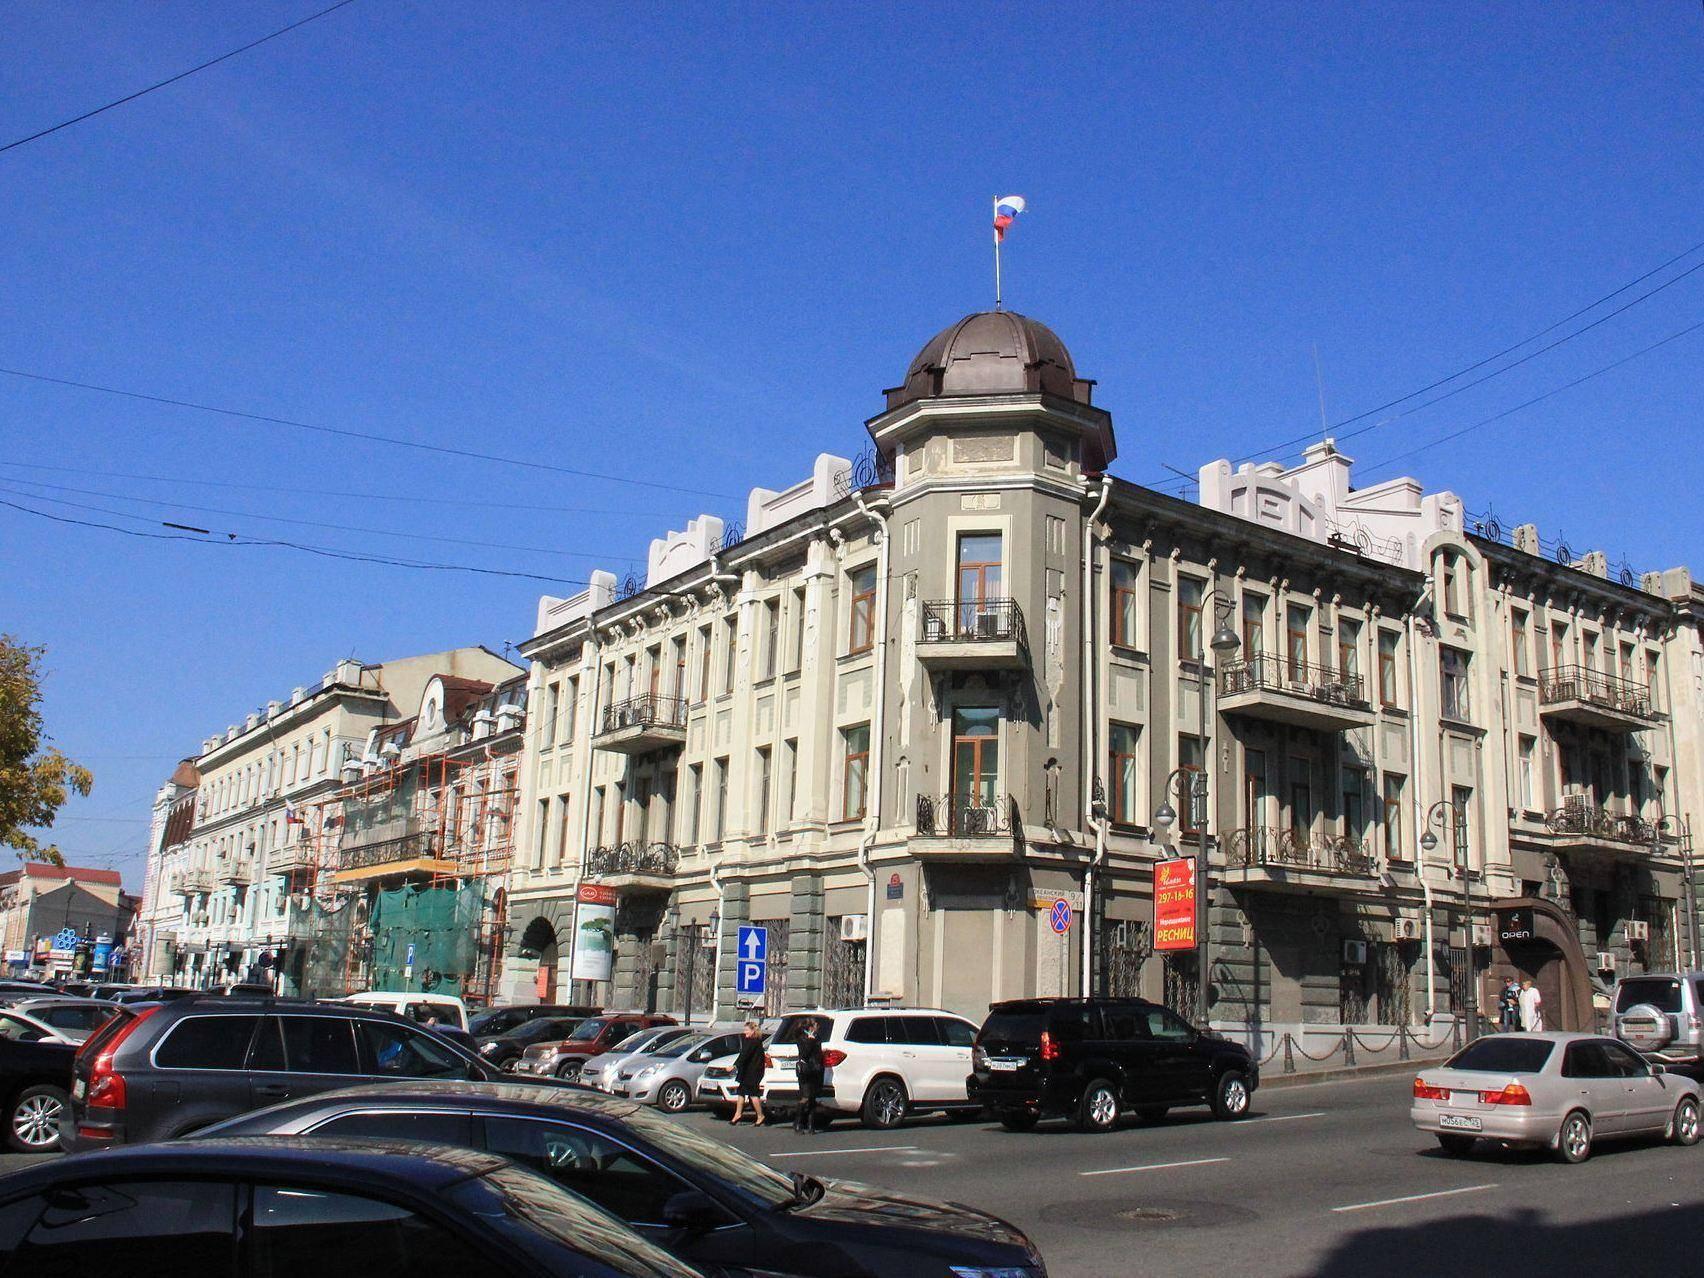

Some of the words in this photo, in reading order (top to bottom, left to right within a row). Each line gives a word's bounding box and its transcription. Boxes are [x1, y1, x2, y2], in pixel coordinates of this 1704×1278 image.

[1158, 888, 1194, 904] 297-16-16
[1157, 927, 1194, 942] РЕСНИЦ
[1501, 931, 1530, 939] OPEN
[744, 964, 761, 990] P
